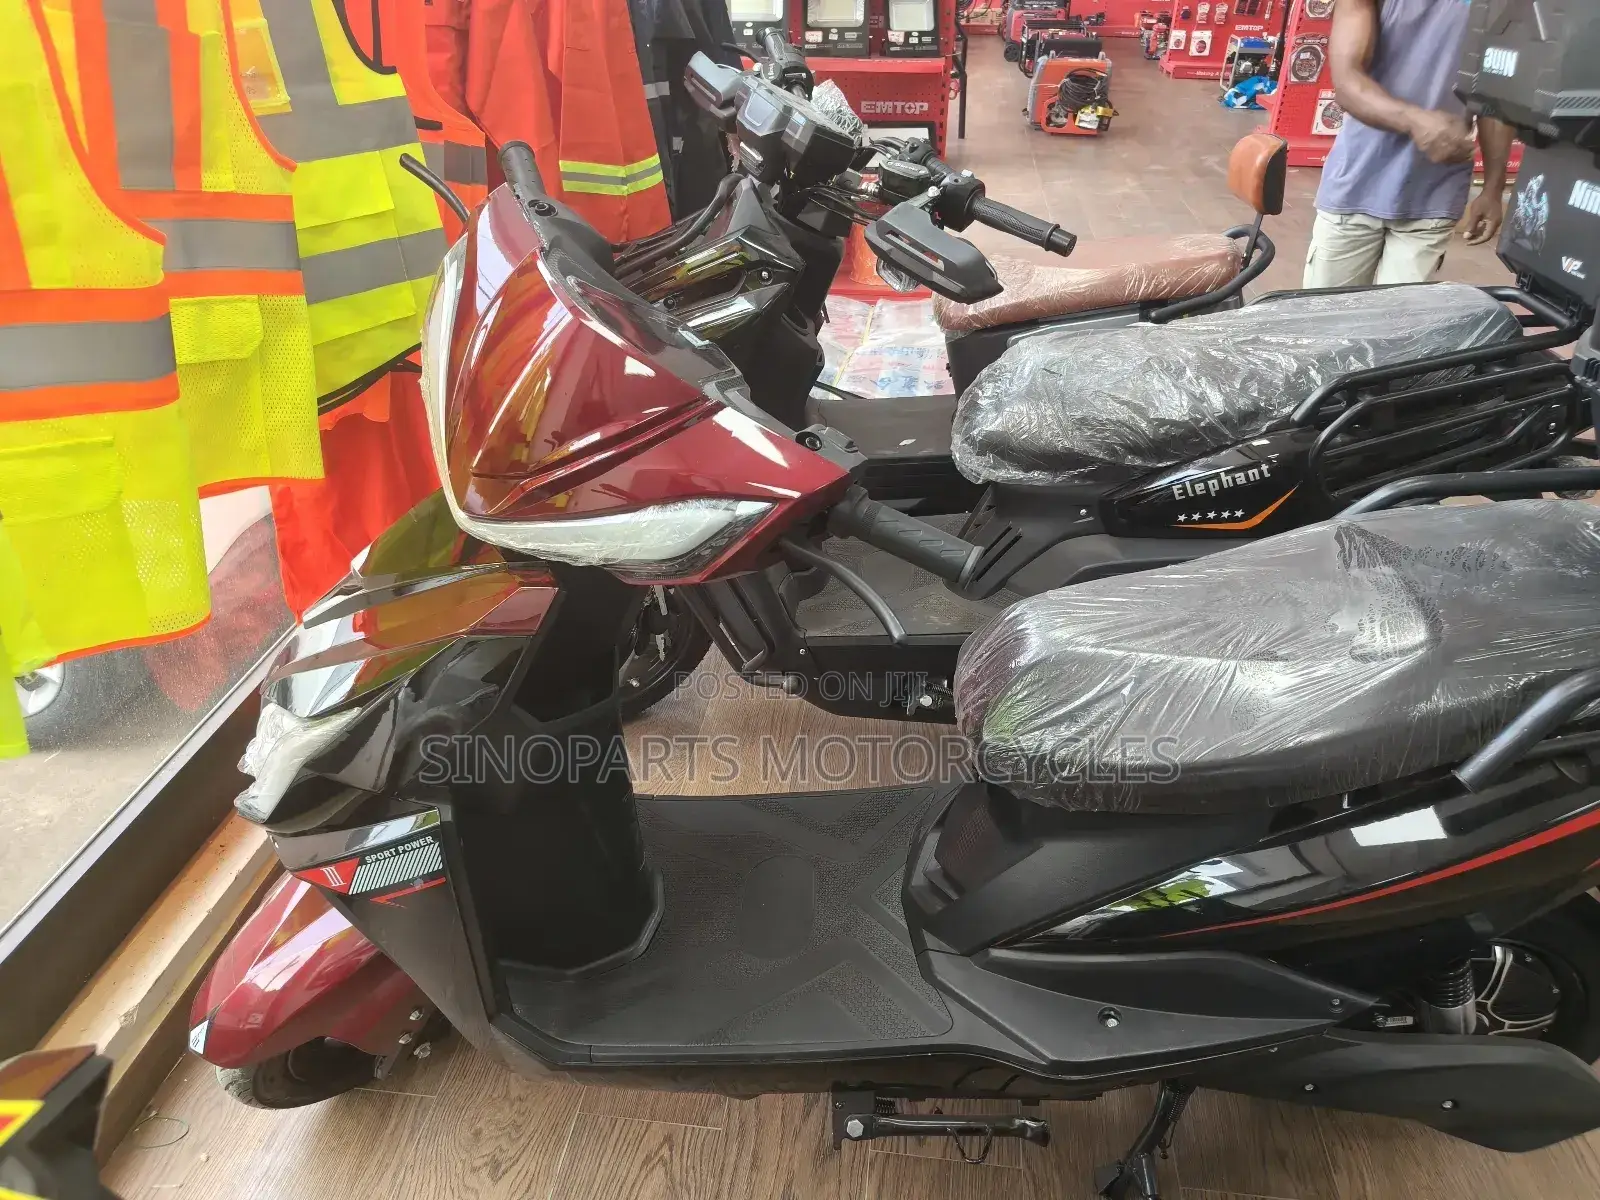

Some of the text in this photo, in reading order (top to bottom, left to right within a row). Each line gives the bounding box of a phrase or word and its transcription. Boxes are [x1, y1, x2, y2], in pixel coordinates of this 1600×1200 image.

[861, 101, 929, 114] EMTOP
[1172, 463, 1271, 500] Elephant
[365, 835, 434, 864] SPORT POWER
